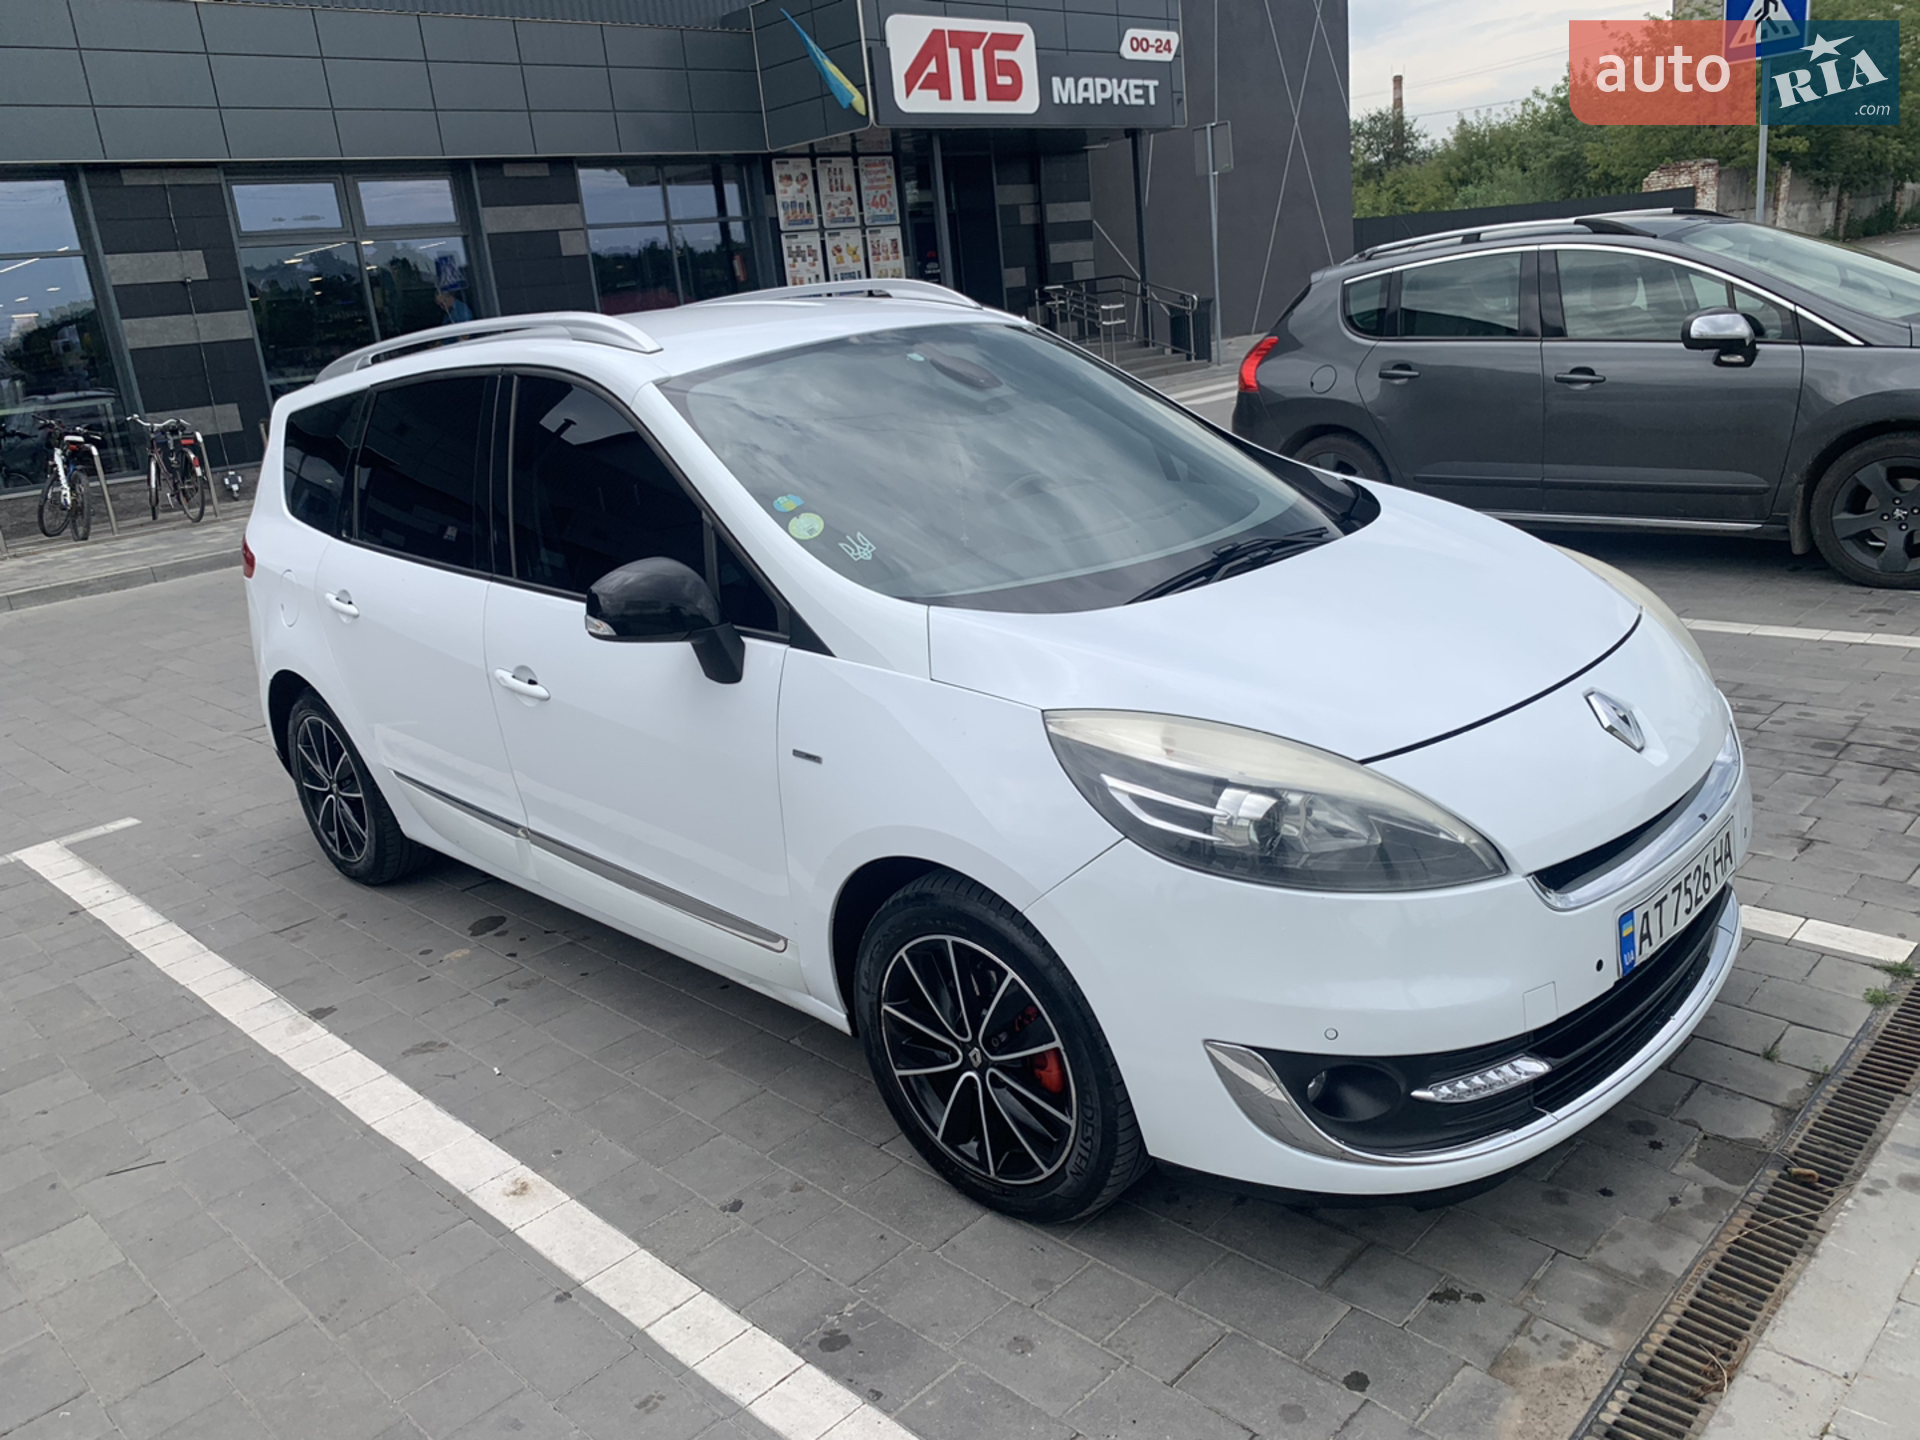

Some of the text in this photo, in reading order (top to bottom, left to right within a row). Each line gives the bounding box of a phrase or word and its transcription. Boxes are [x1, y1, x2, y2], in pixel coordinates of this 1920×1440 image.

[904, 28, 1024, 102] АТБ
[1129, 36, 1173, 54] 00-24
[1051, 75, 1159, 106] МАРКЕТ
[1671, 854, 1712, 928] 7526
